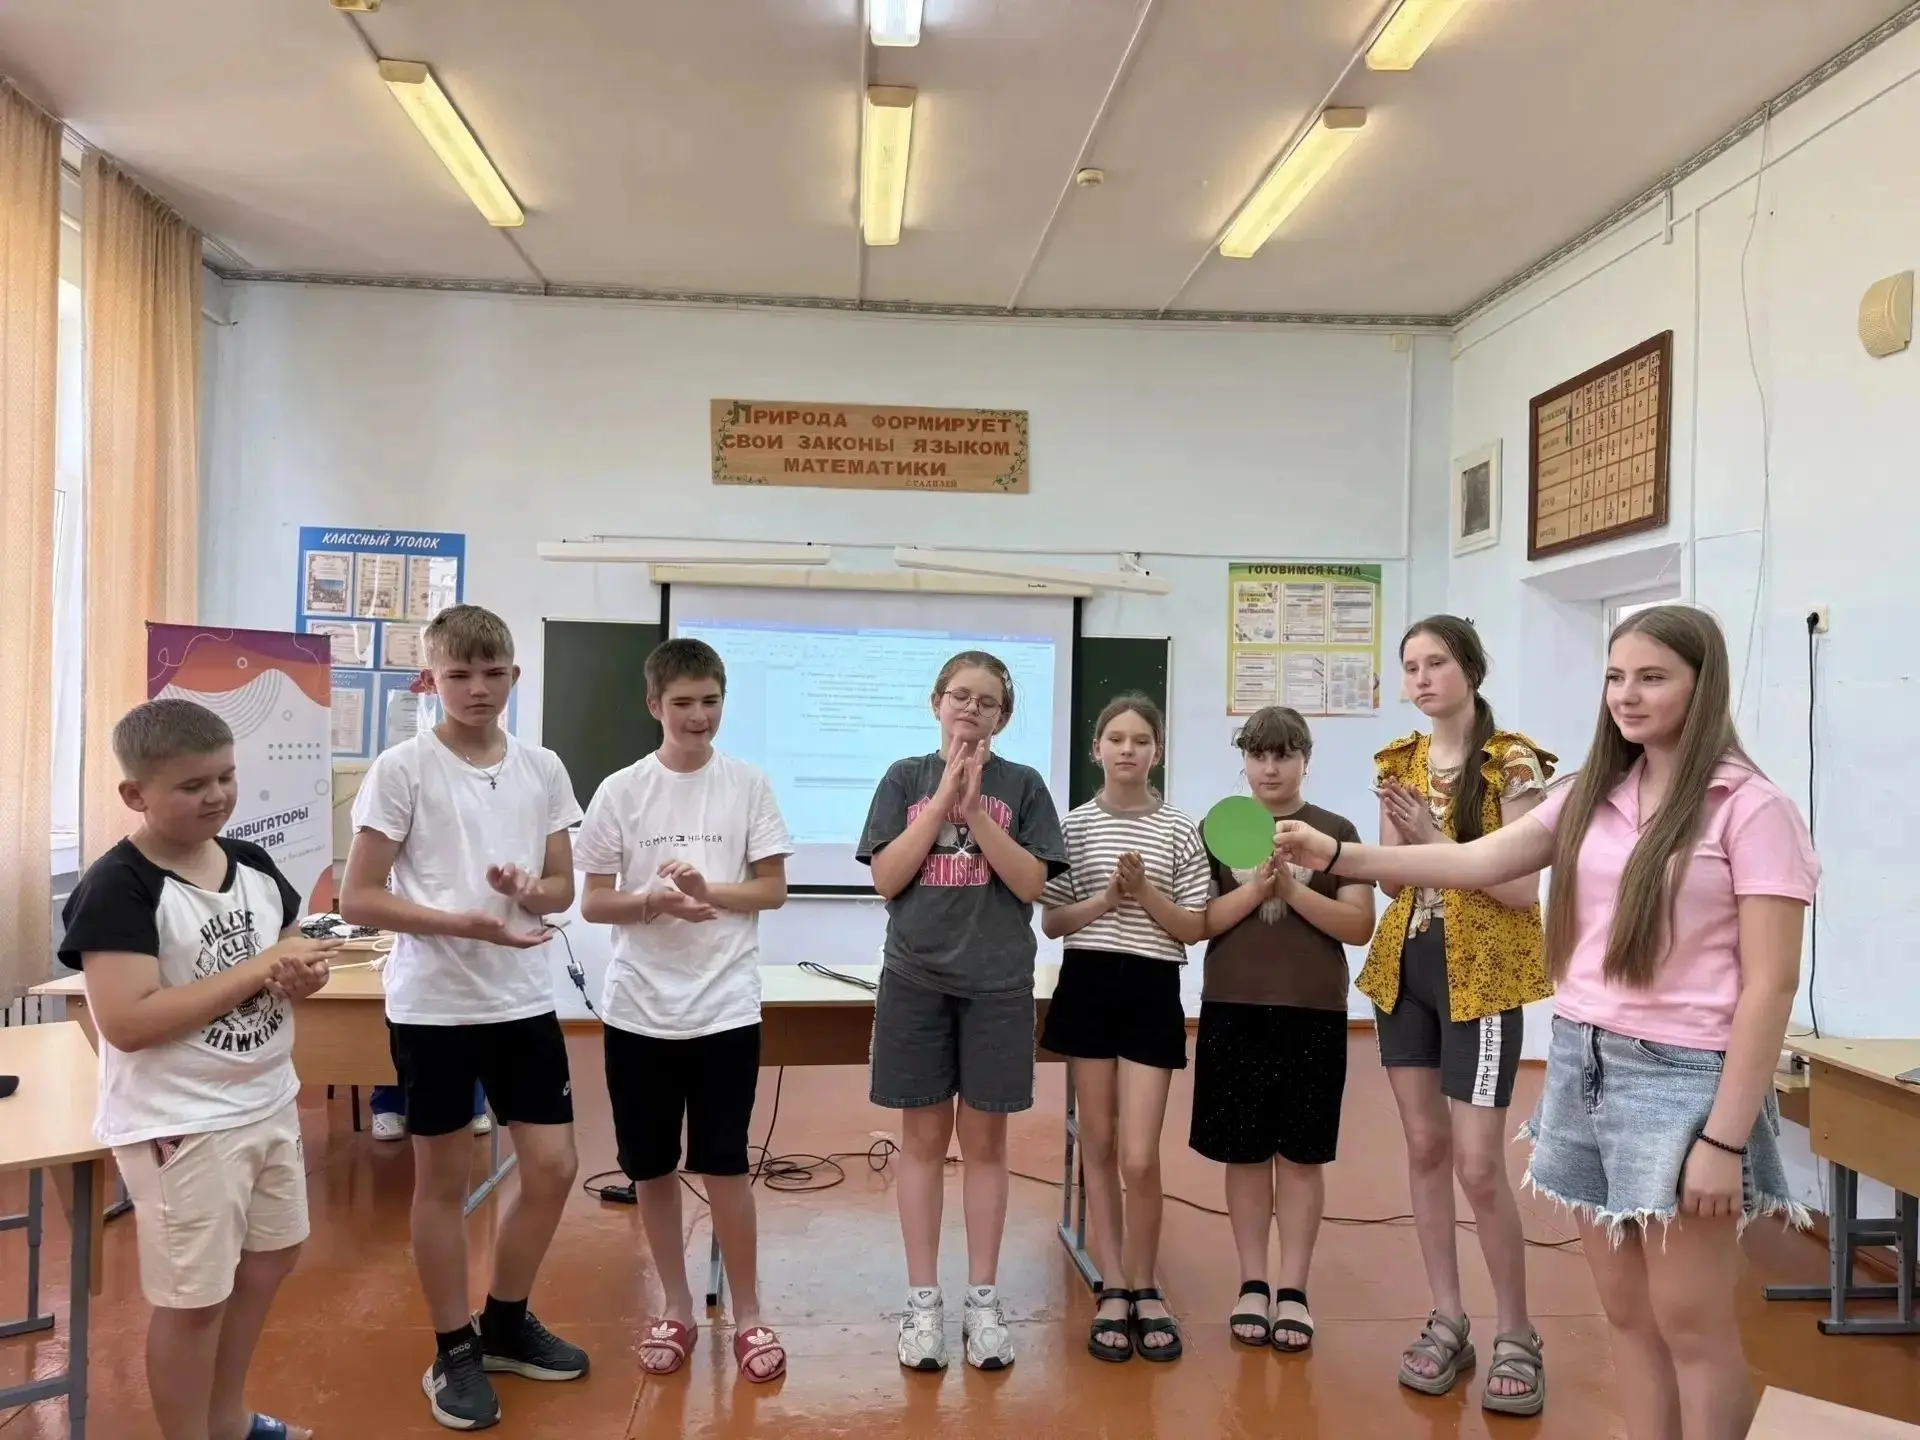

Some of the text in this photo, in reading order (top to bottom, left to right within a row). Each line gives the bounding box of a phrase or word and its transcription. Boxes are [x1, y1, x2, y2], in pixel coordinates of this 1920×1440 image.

[872, 414, 1011, 433] ФОРМИРУЕТ
[722, 434, 1010, 455] СВОИ ЗАКОНЫ ЯЗЫКОМ
[784, 458, 946, 477] МАТЕМАТИКИ
[322, 532, 440, 549] КЛАССНЫЙ УГОЛОК
[1248, 565, 1361, 576] ГОТОВИМСЯ К ГИА
[226, 807, 309, 840] НАВИГАТОРЫ
[639, 836, 673, 848] TOMMY
[687, 834, 723, 843] HILFGER
[204, 1009, 284, 1052] HAWKINS
[1480, 1016, 1494, 1096] STAY STRONG
